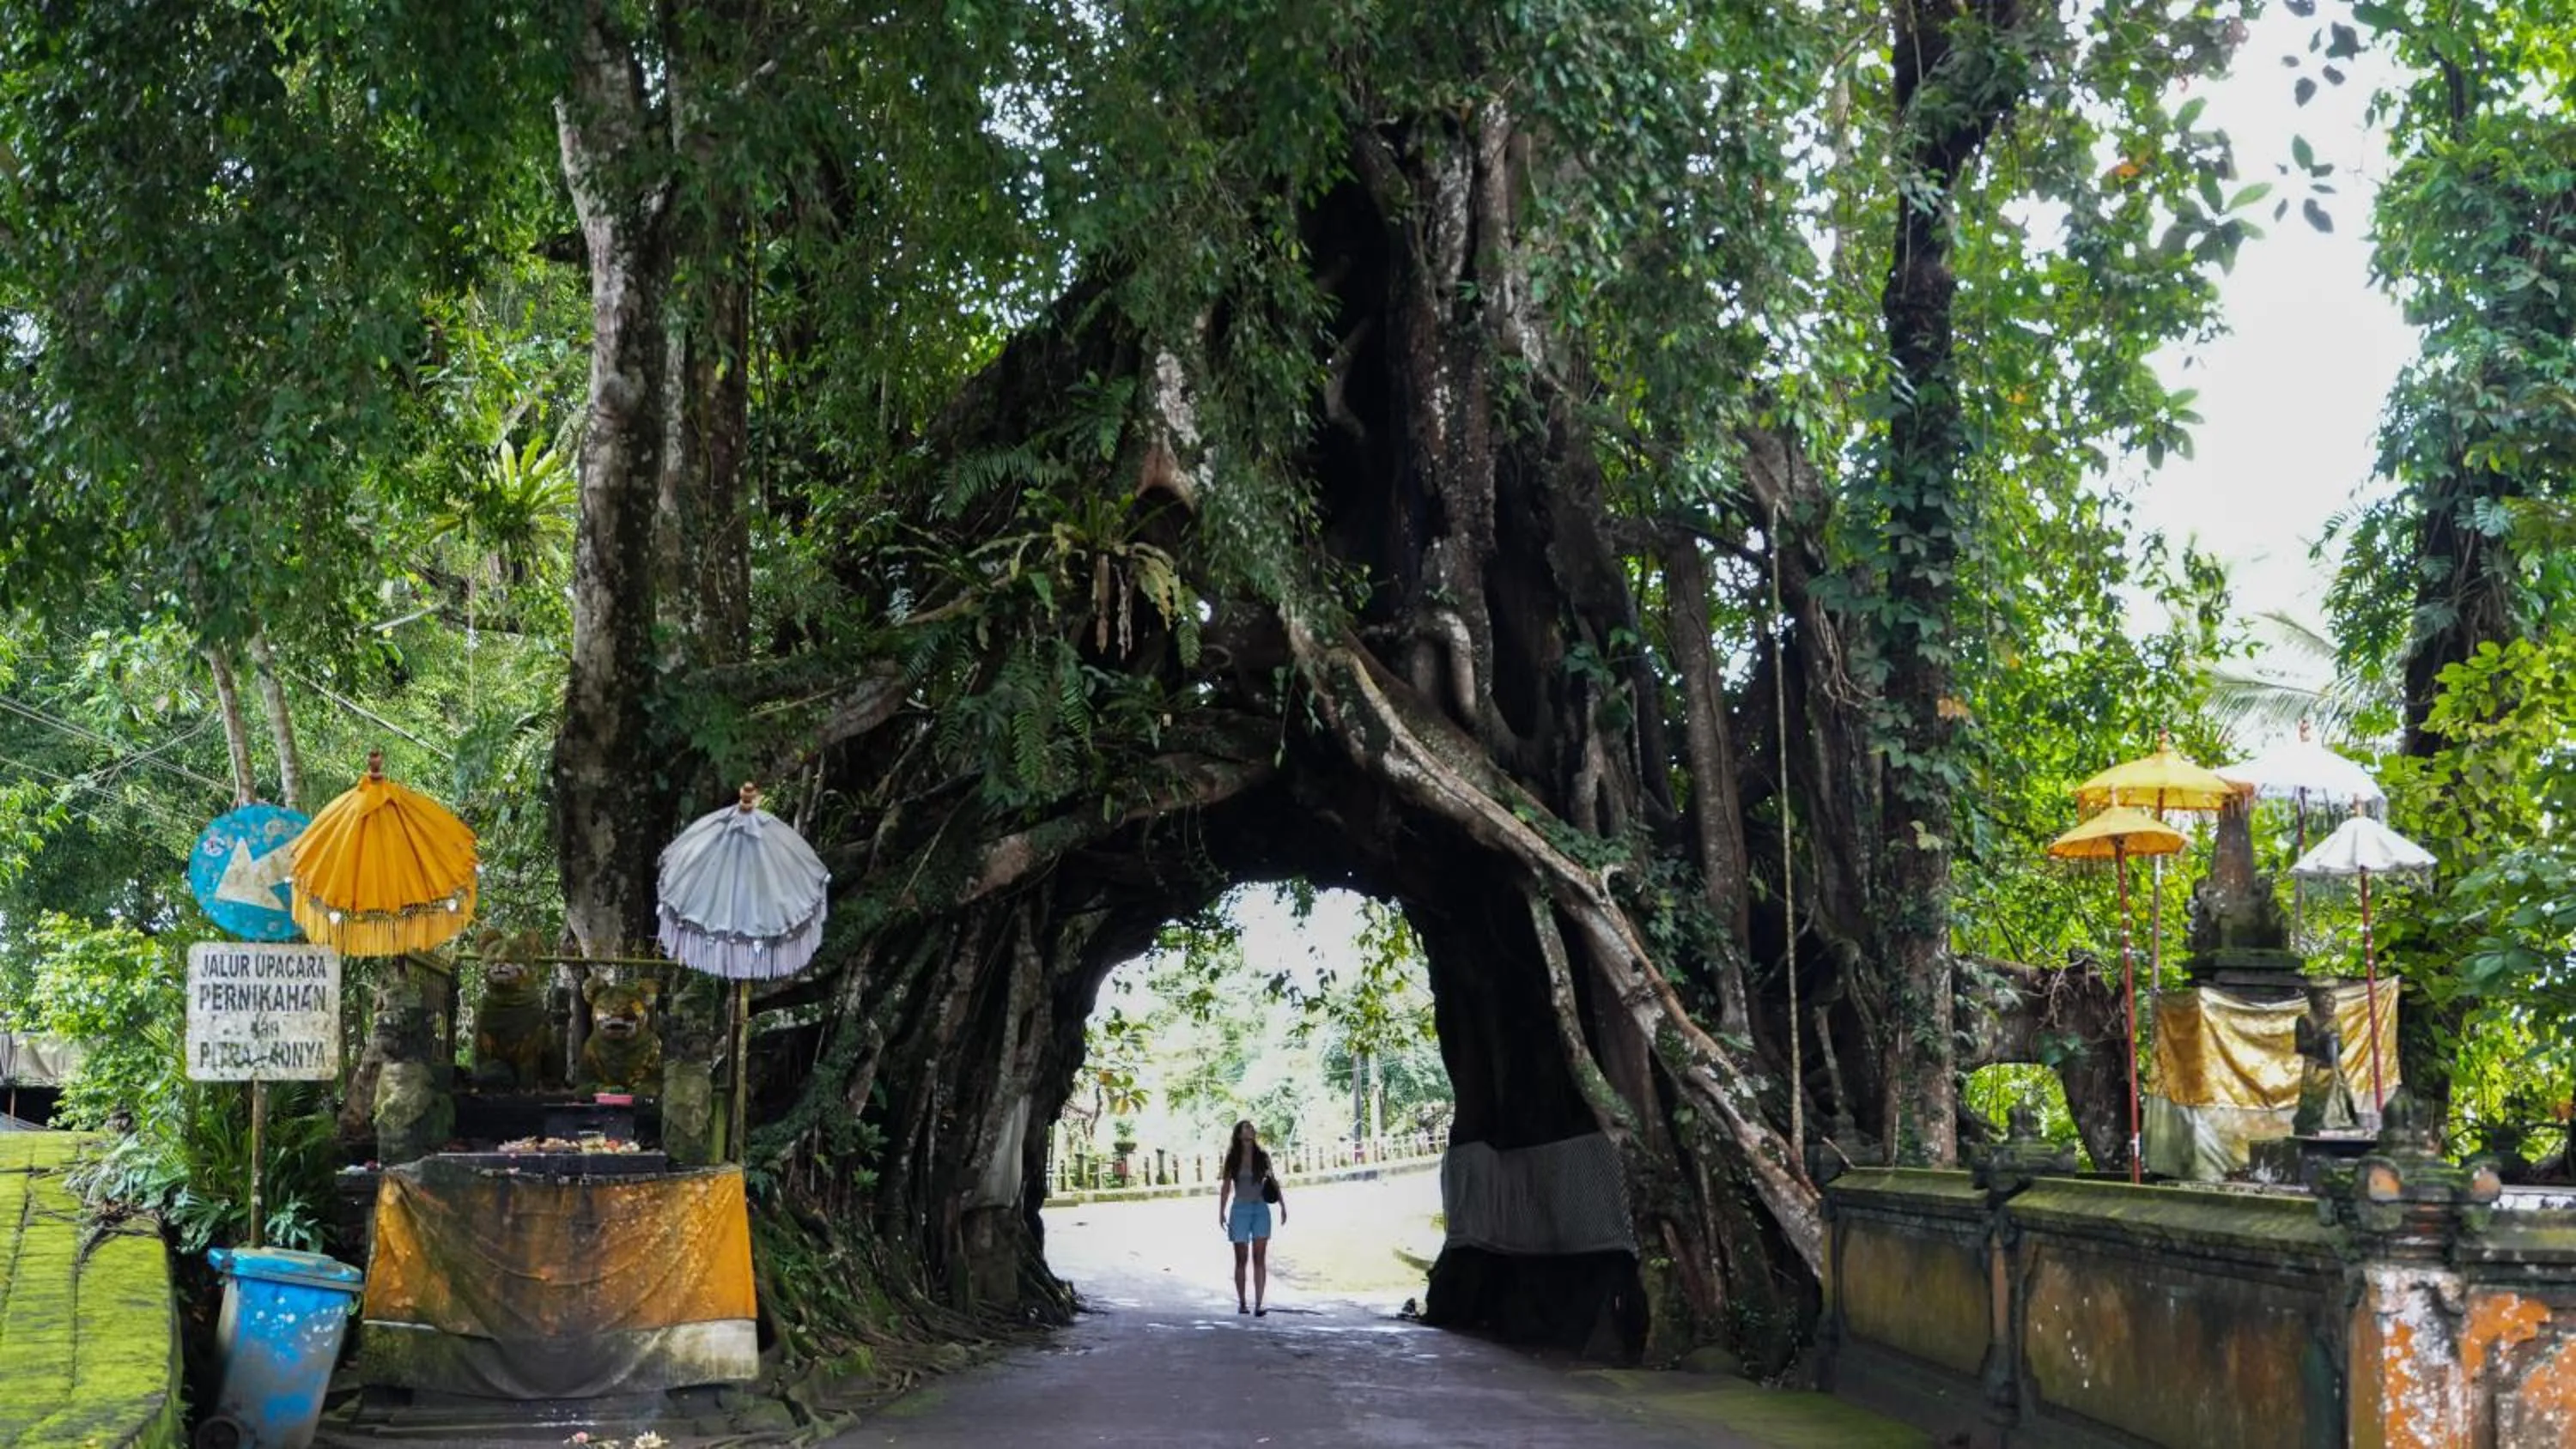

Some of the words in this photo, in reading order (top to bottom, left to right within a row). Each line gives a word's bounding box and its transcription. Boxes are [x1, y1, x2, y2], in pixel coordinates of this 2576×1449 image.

[200, 954, 250, 979] JALUR
[255, 955, 327, 979] UPACARA
[198, 984, 327, 1011] PERNIKAHAN
